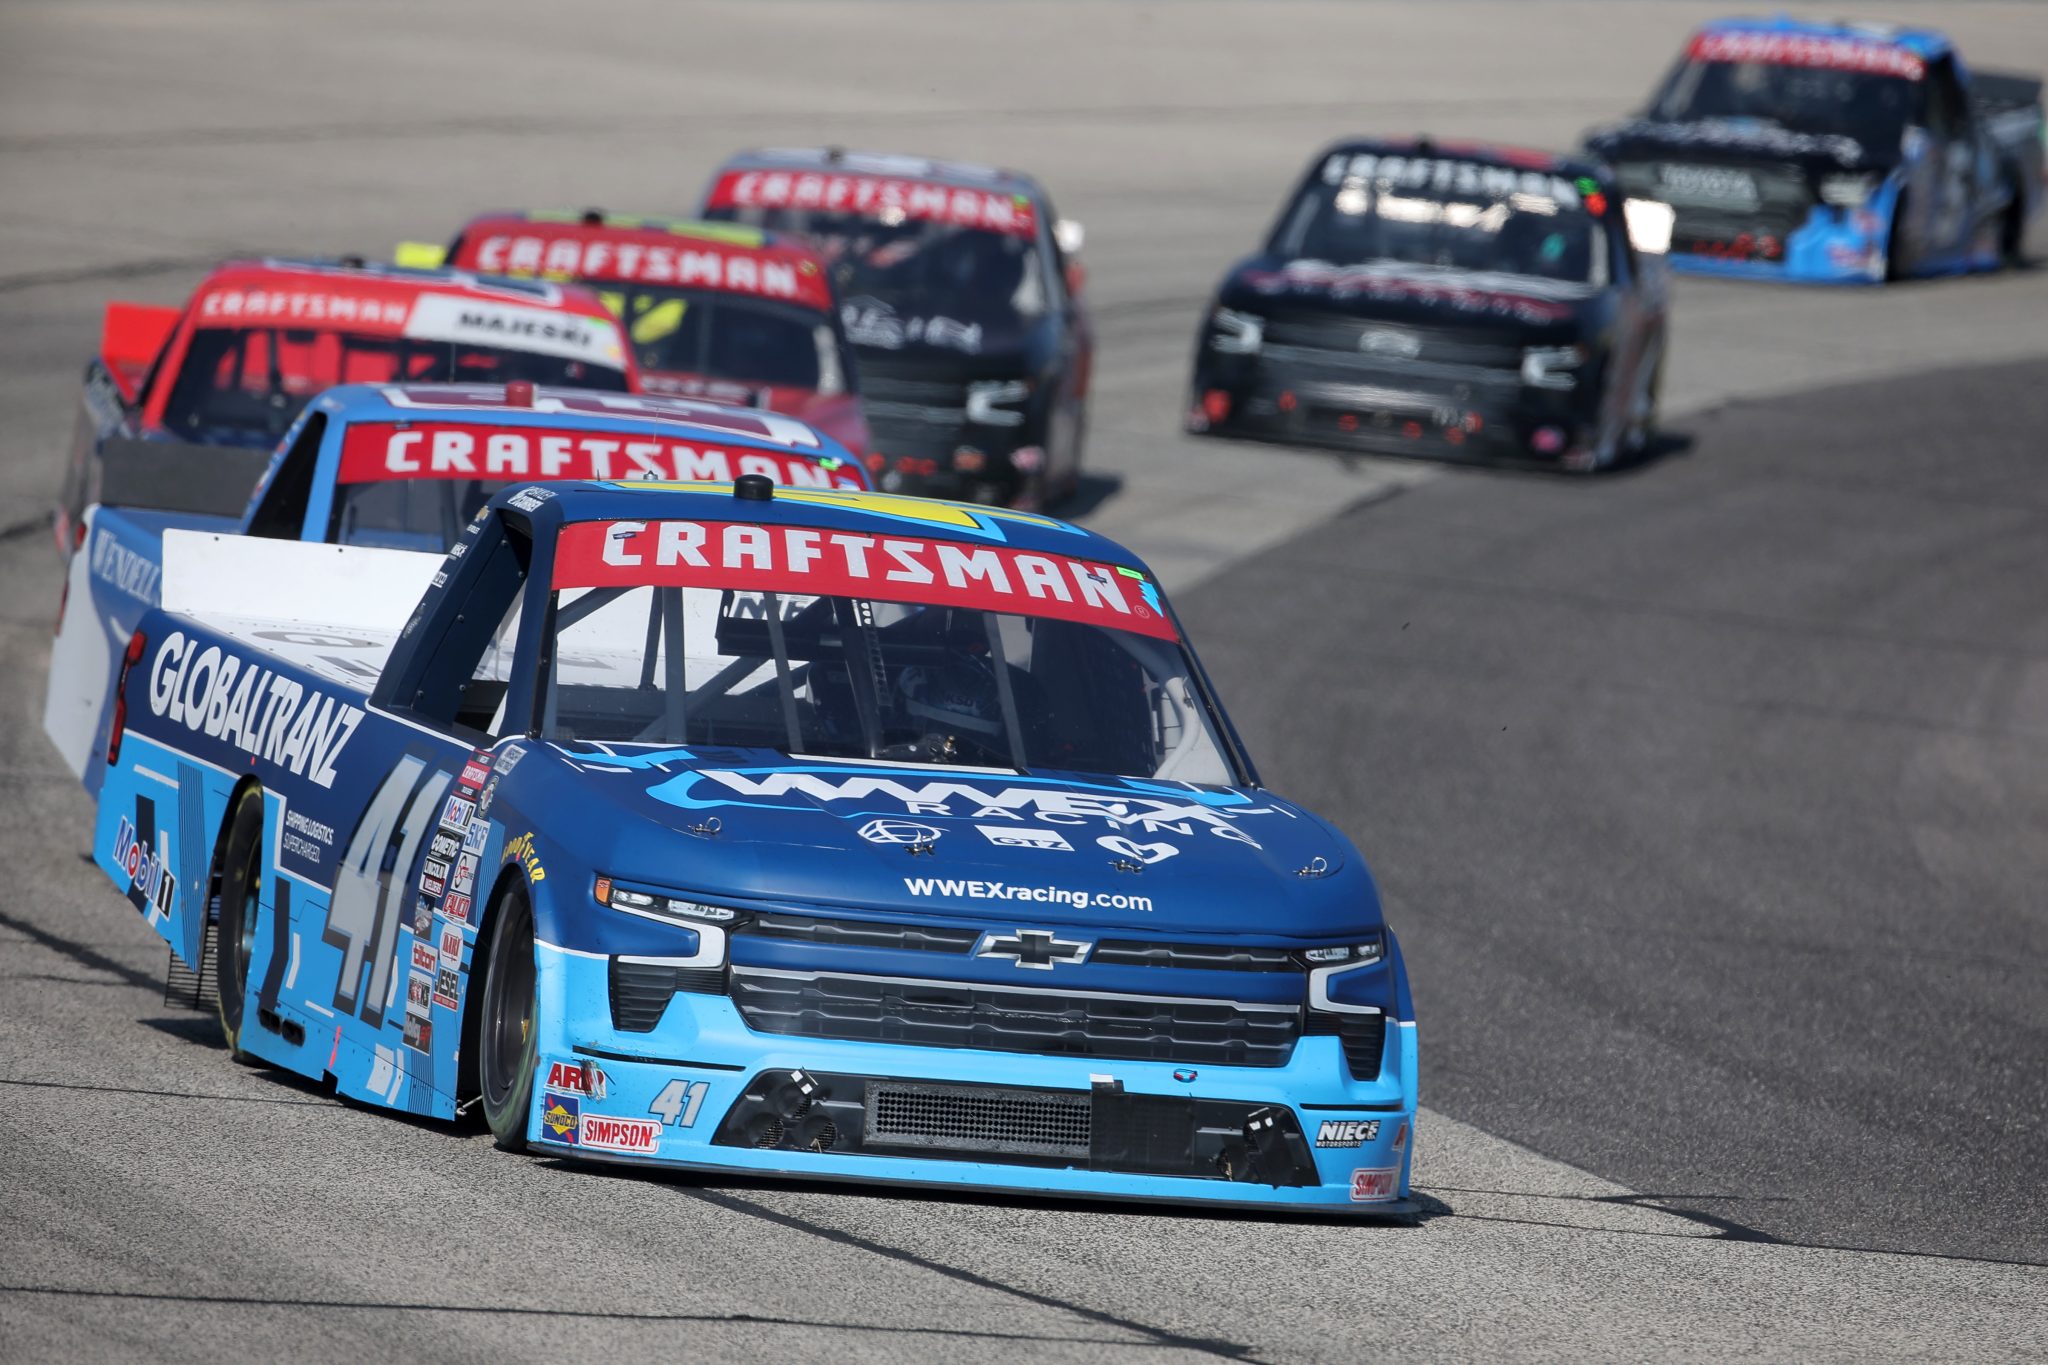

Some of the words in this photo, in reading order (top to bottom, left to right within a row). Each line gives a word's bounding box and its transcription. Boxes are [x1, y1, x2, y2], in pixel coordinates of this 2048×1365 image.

[731, 172, 1017, 228] CRAFTSMAN
[477, 236, 798, 296] CRAFTSMAN
[202, 292, 406, 325] CRAFTSMAN
[459, 311, 594, 346] MAJESKI
[602, 521, 1132, 615] CRAFTSMAN
[150, 632, 366, 789] GLOBALTRANZ
[113, 815, 160, 903] Mobil
[431, 834, 460, 857] COMETIC
[465, 822, 489, 850] SKF
[327, 752, 453, 1016] 41
[904, 878, 1153, 912] WWEXracing.com
[544, 1111, 577, 1128] SUNOCO
[648, 1079, 710, 1128] 41
[585, 1120, 653, 1147] SIMPSON
